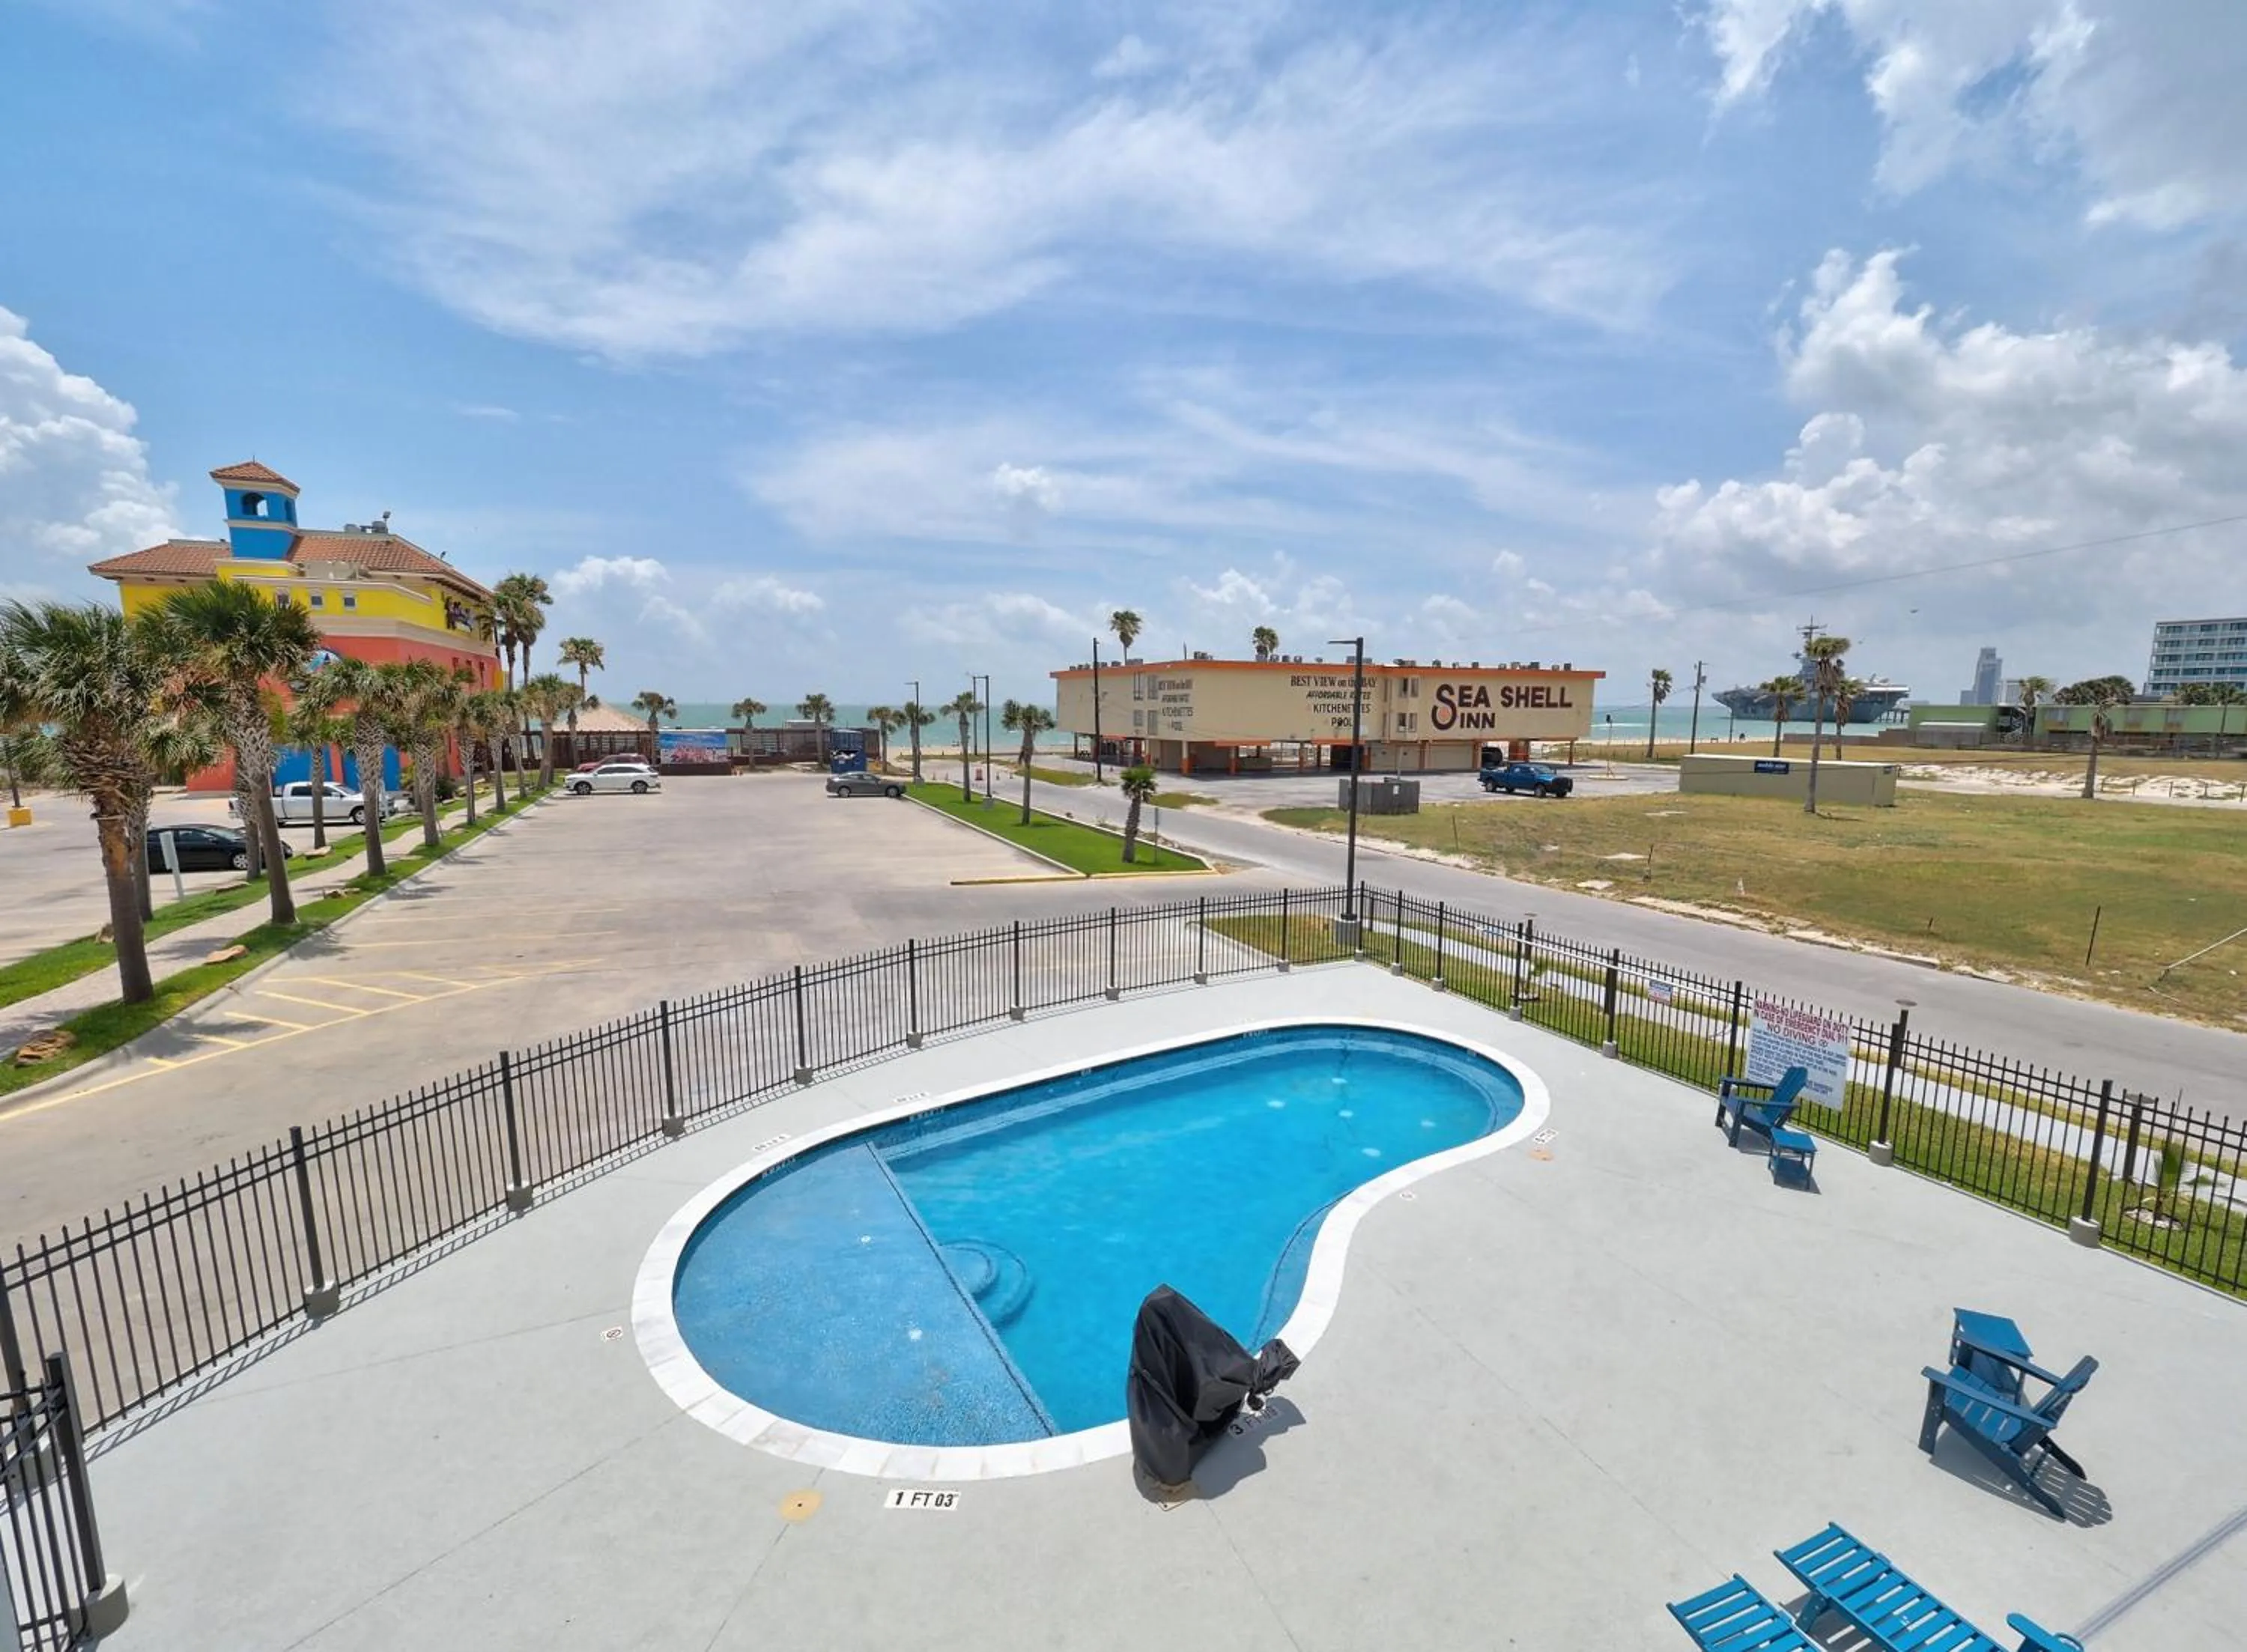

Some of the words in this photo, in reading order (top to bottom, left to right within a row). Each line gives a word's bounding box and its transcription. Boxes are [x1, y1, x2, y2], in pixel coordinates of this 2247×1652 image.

[1291, 675, 1311, 687] BEST
[1313, 675, 1336, 687] VIEW
[1431, 683, 1491, 730] SEA
[1500, 685, 1573, 708] SHELL
[1460, 712, 1496, 729] INN
[1767, 1022, 1780, 1034] NO
[1783, 1027, 1816, 1045] DIVING
[895, 1491, 904, 1506] 1
[910, 1492, 934, 1507] FT
